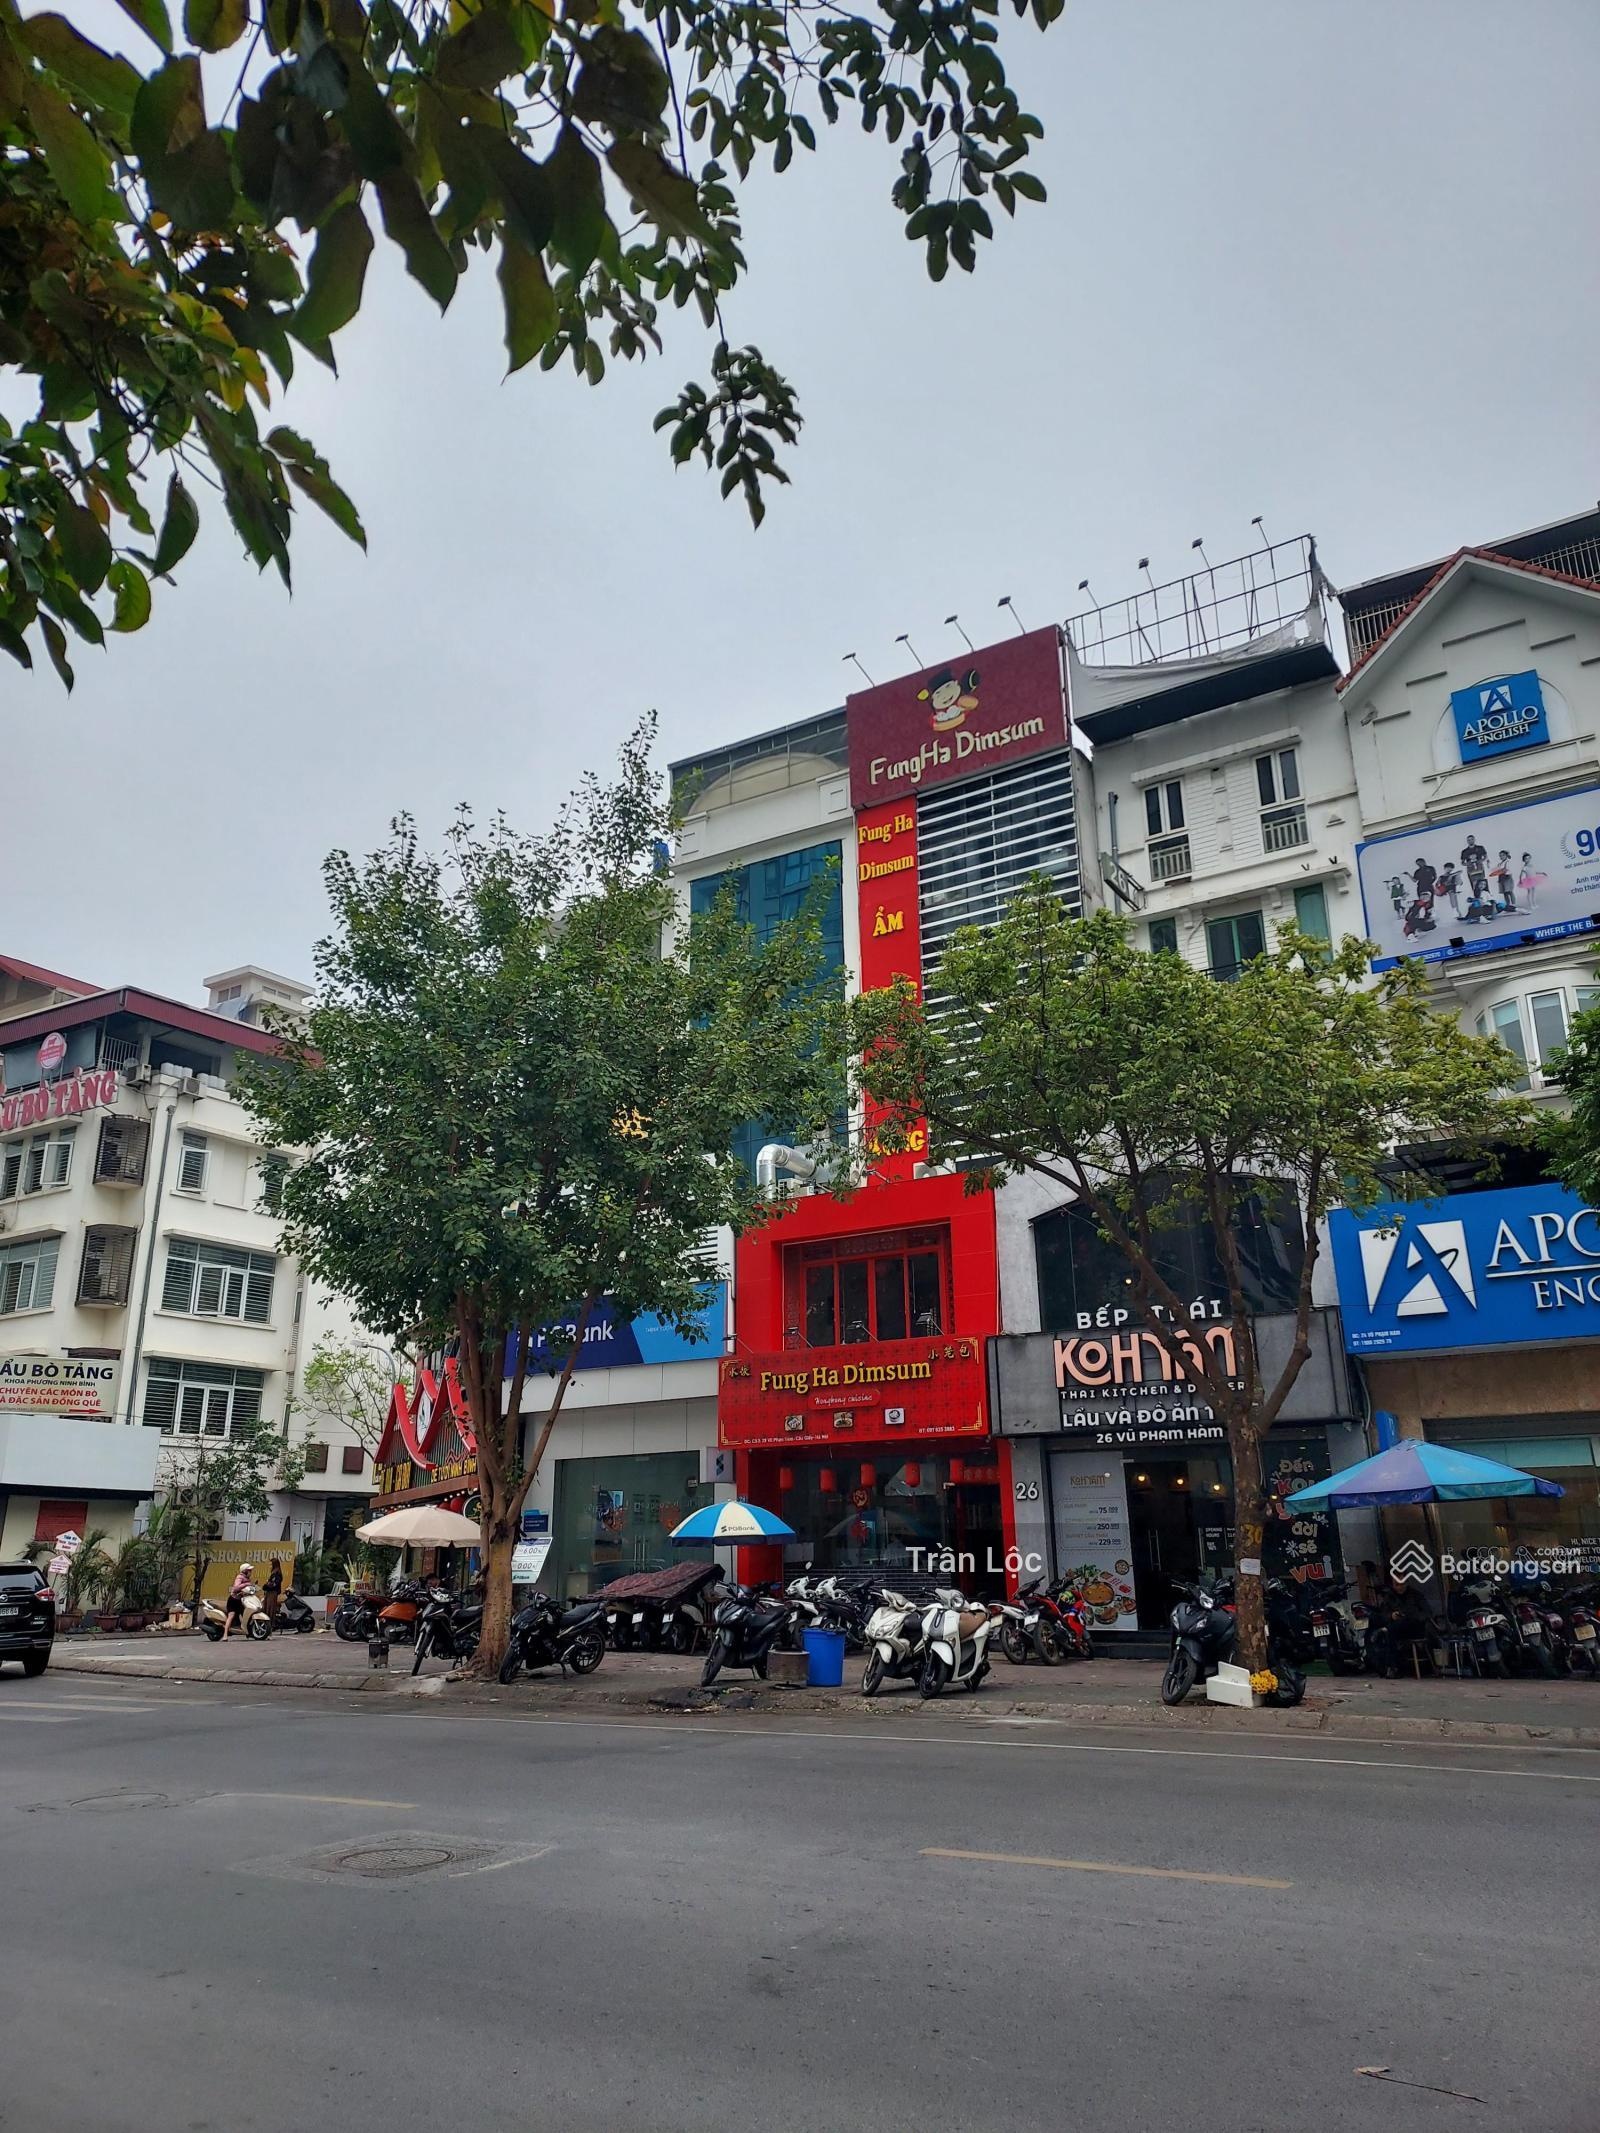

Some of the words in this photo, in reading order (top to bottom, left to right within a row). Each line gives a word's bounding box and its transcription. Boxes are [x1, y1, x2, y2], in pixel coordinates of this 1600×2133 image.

[1463, 706, 1539, 737] APOLLO
[955, 716, 1045, 759] Dimsum
[1477, 724, 1529, 745] ENGLISH
[858, 824, 892, 844] Fung
[894, 814, 914, 833] Ha
[859, 854, 915, 882] Dimsum
[1535, 926, 1567, 938] WHERE
[1568, 921, 1584, 932] THE
[21, 1080, 50, 1127] BÒ
[55, 1066, 117, 1117] TẢNG
[1076, 1303, 1129, 1330] BẾP
[1150, 1296, 1223, 1322] TÁI
[31, 1362, 59, 1377] BÒ
[63, 1362, 113, 1380] TẢNG
[760, 1371, 808, 1394] Fung
[812, 1366, 839, 1387] Ha
[843, 1361, 932, 1384] Dimsum
[26, 1378, 58, 1386] PHƯƠNG
[1061, 1389, 1096, 1399] THAI
[1102, 1385, 1168, 1398] KITCHEN
[1173, 1385, 1181, 1394] &
[1188, 1381, 1245, 1392] DER
[0, 1387, 37, 1395] CHUYÊN
[40, 1387, 59, 1396] CÁC
[60, 1388, 83, 1397] MÓN
[85, 1389, 98, 1397] BÒ
[8, 1396, 30, 1406] ĐẶC
[30, 1396, 50, 1404] SẢN
[52, 1396, 80, 1406] ĐỒNG
[82, 1398, 102, 1407] QUÊ
[1104, 1406, 1132, 1425] VÀ
[1137, 1401, 1166, 1423] ĐỒ
[1171, 1402, 1200, 1421] ĂN
[1096, 1433, 1113, 1444] 26
[1116, 1428, 1136, 1442] VŨ
[1139, 1428, 1183, 1444] PHẠM
[1187, 1425, 1224, 1439] HÀM
[1279, 1457, 1315, 1473] Đến
[1015, 1481, 1038, 1500] 26
[1277, 1478, 1315, 1495] KO
[1581, 1537, 1597, 1545] NICE
